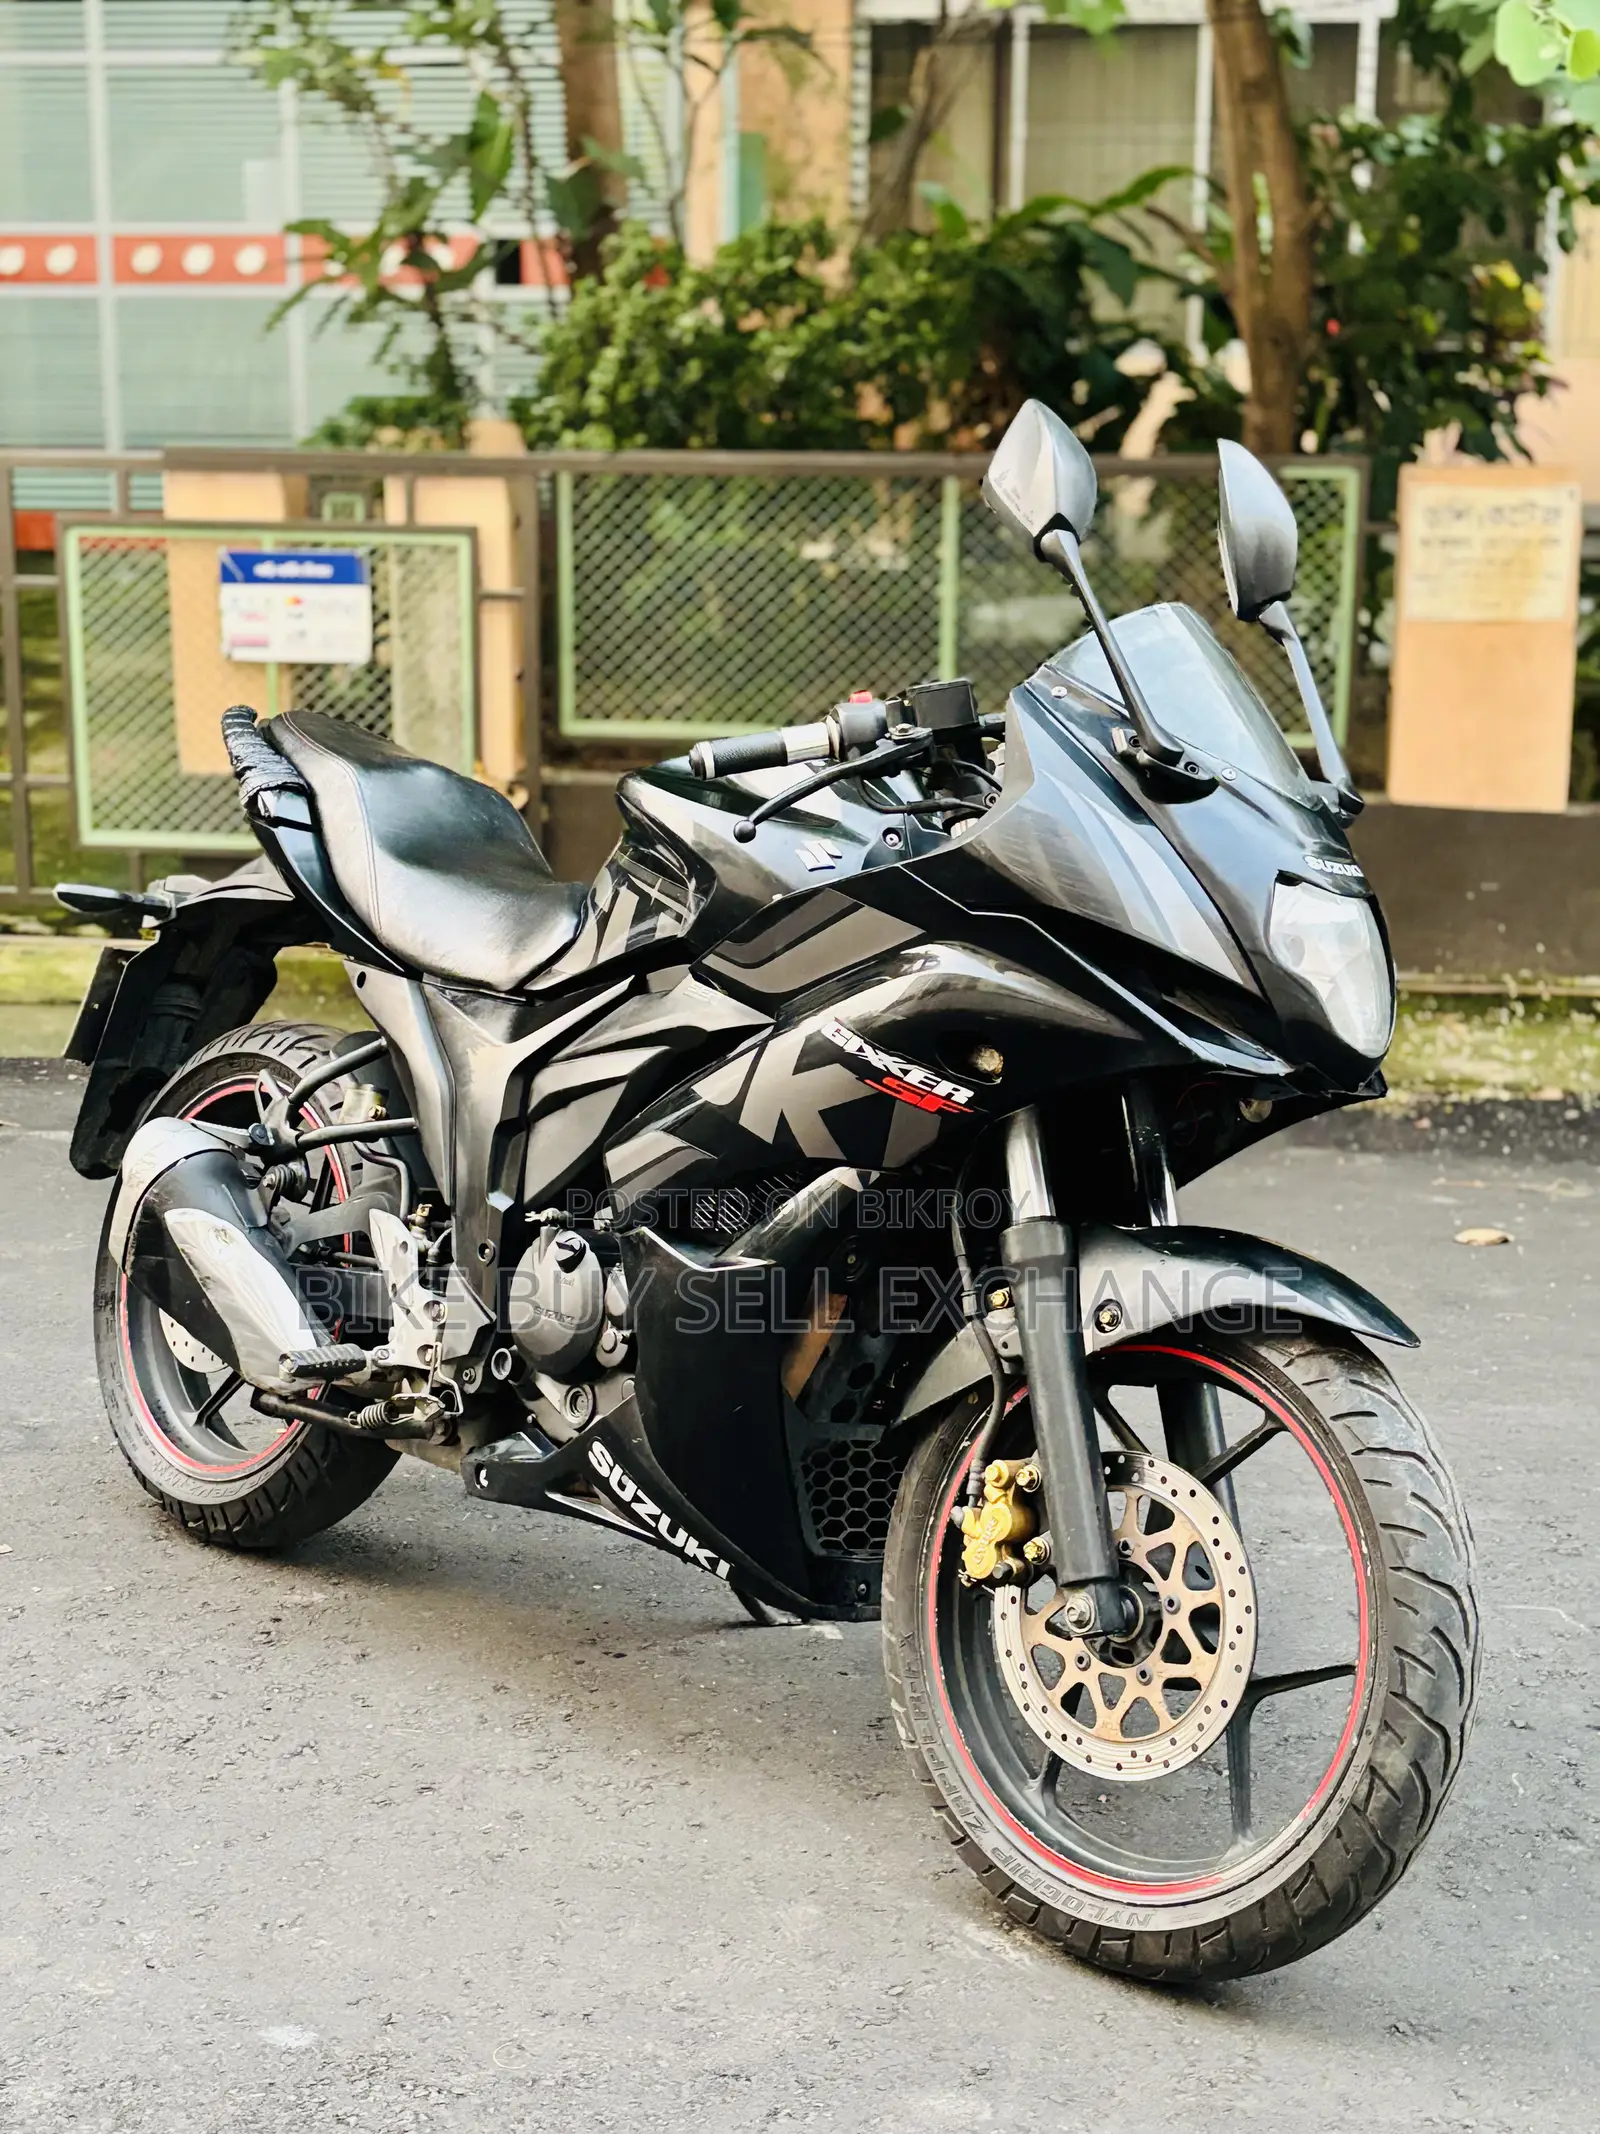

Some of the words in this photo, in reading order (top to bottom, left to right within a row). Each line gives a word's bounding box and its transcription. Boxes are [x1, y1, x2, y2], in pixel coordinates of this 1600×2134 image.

[820, 1019, 975, 1105] GIXXER
[863, 1076, 975, 1114] SF
[587, 1440, 731, 1580] SUZUKI
[990, 1846, 1155, 1928] NYLOGRIP
